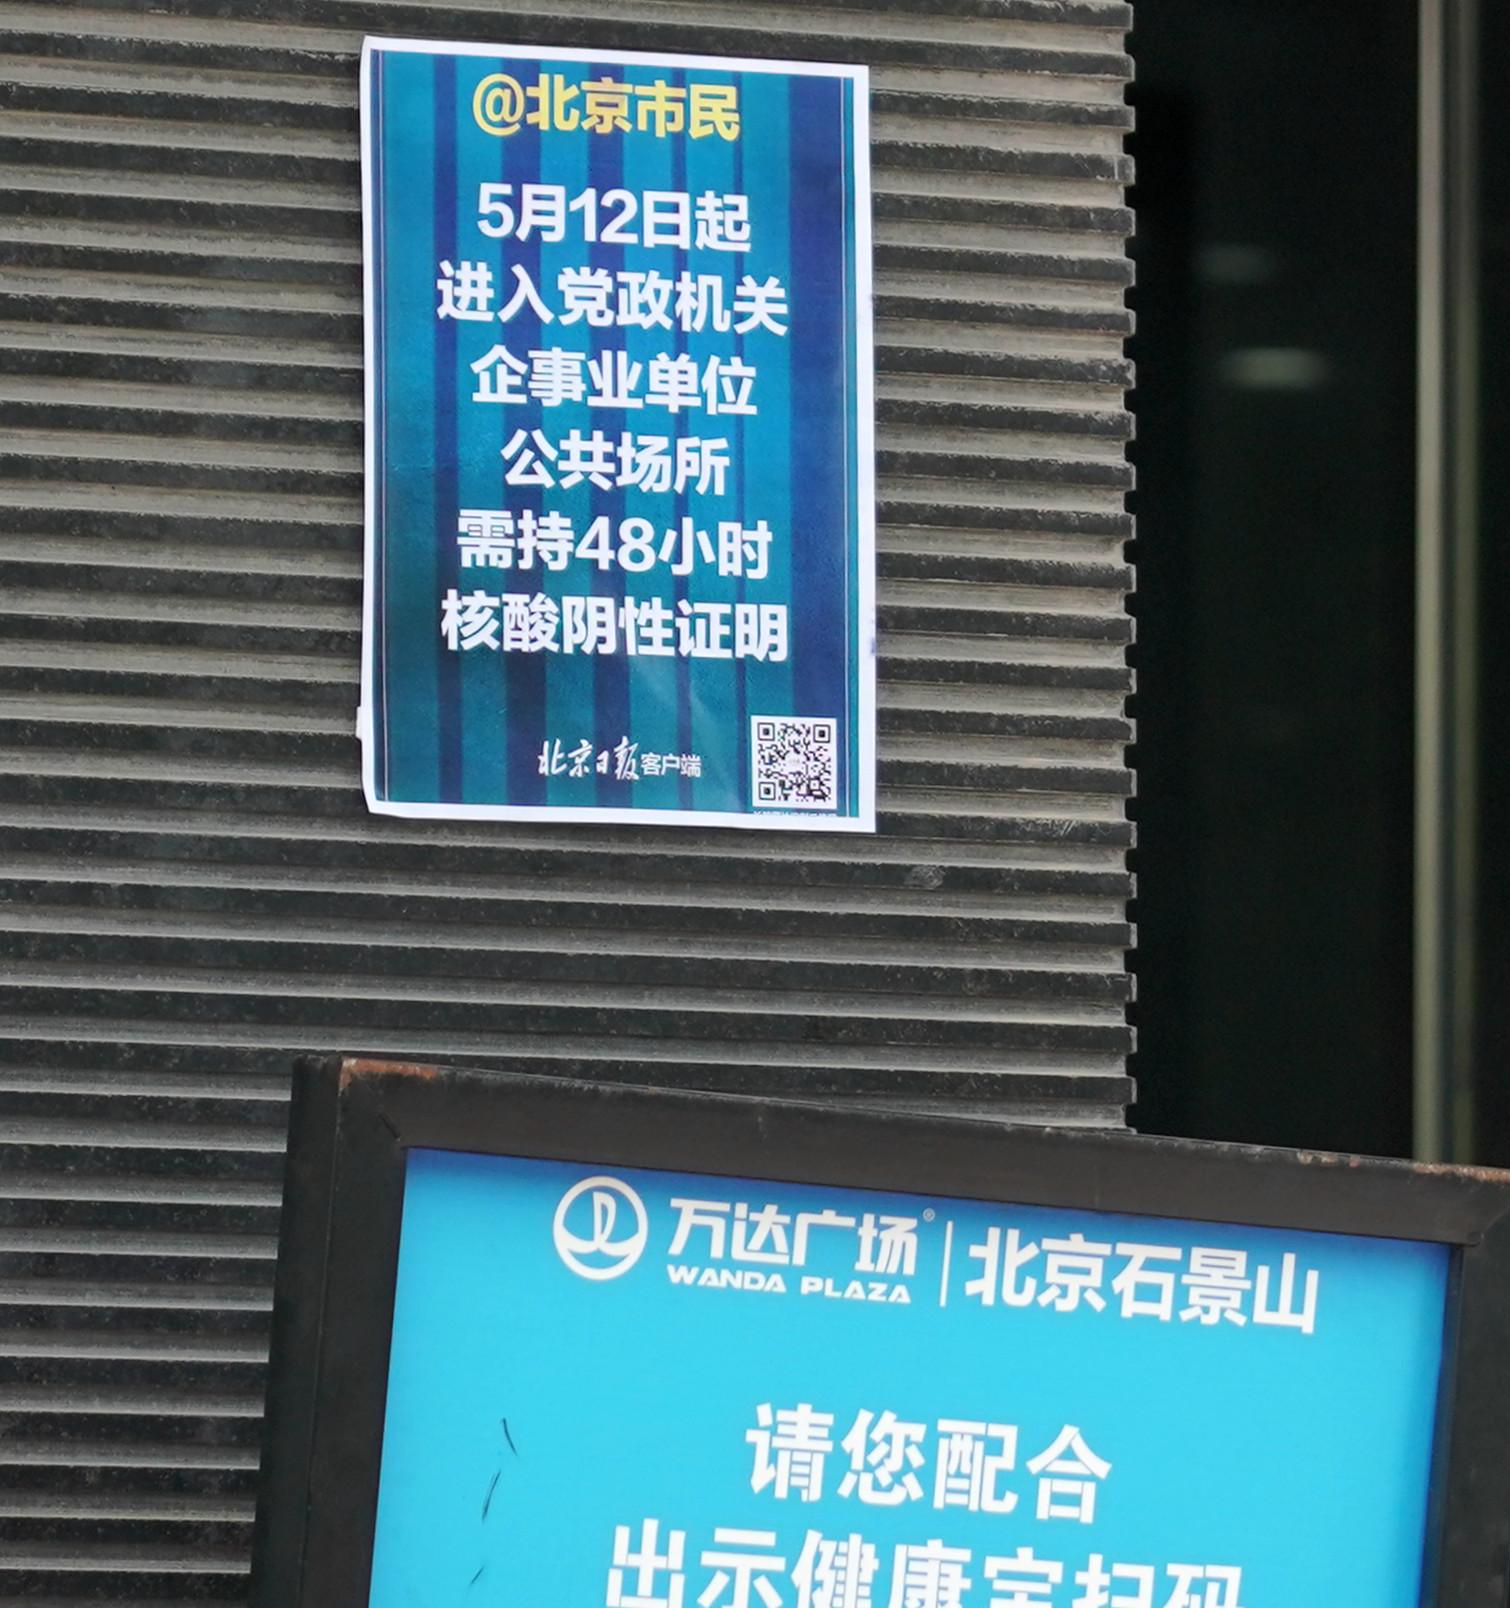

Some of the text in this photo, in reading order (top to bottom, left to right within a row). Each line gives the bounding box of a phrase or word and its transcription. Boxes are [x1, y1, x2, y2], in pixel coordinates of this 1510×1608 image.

[472, 72, 742, 143] @北京市民
[477, 183, 751, 252] 5月12日起
[436, 260, 788, 336] 进入党政机关
[470, 348, 757, 416] 企事业单位
[501, 429, 730, 496] 公共场所
[457, 508, 773, 579] 需持48小时
[440, 588, 788, 662] 核酸阴性证明
[667, 1264, 911, 1304] WANDA PLAZA
[668, 1198, 1321, 1335] 万达广场 北京石景山
[745, 1403, 1111, 1525] 请您配合
